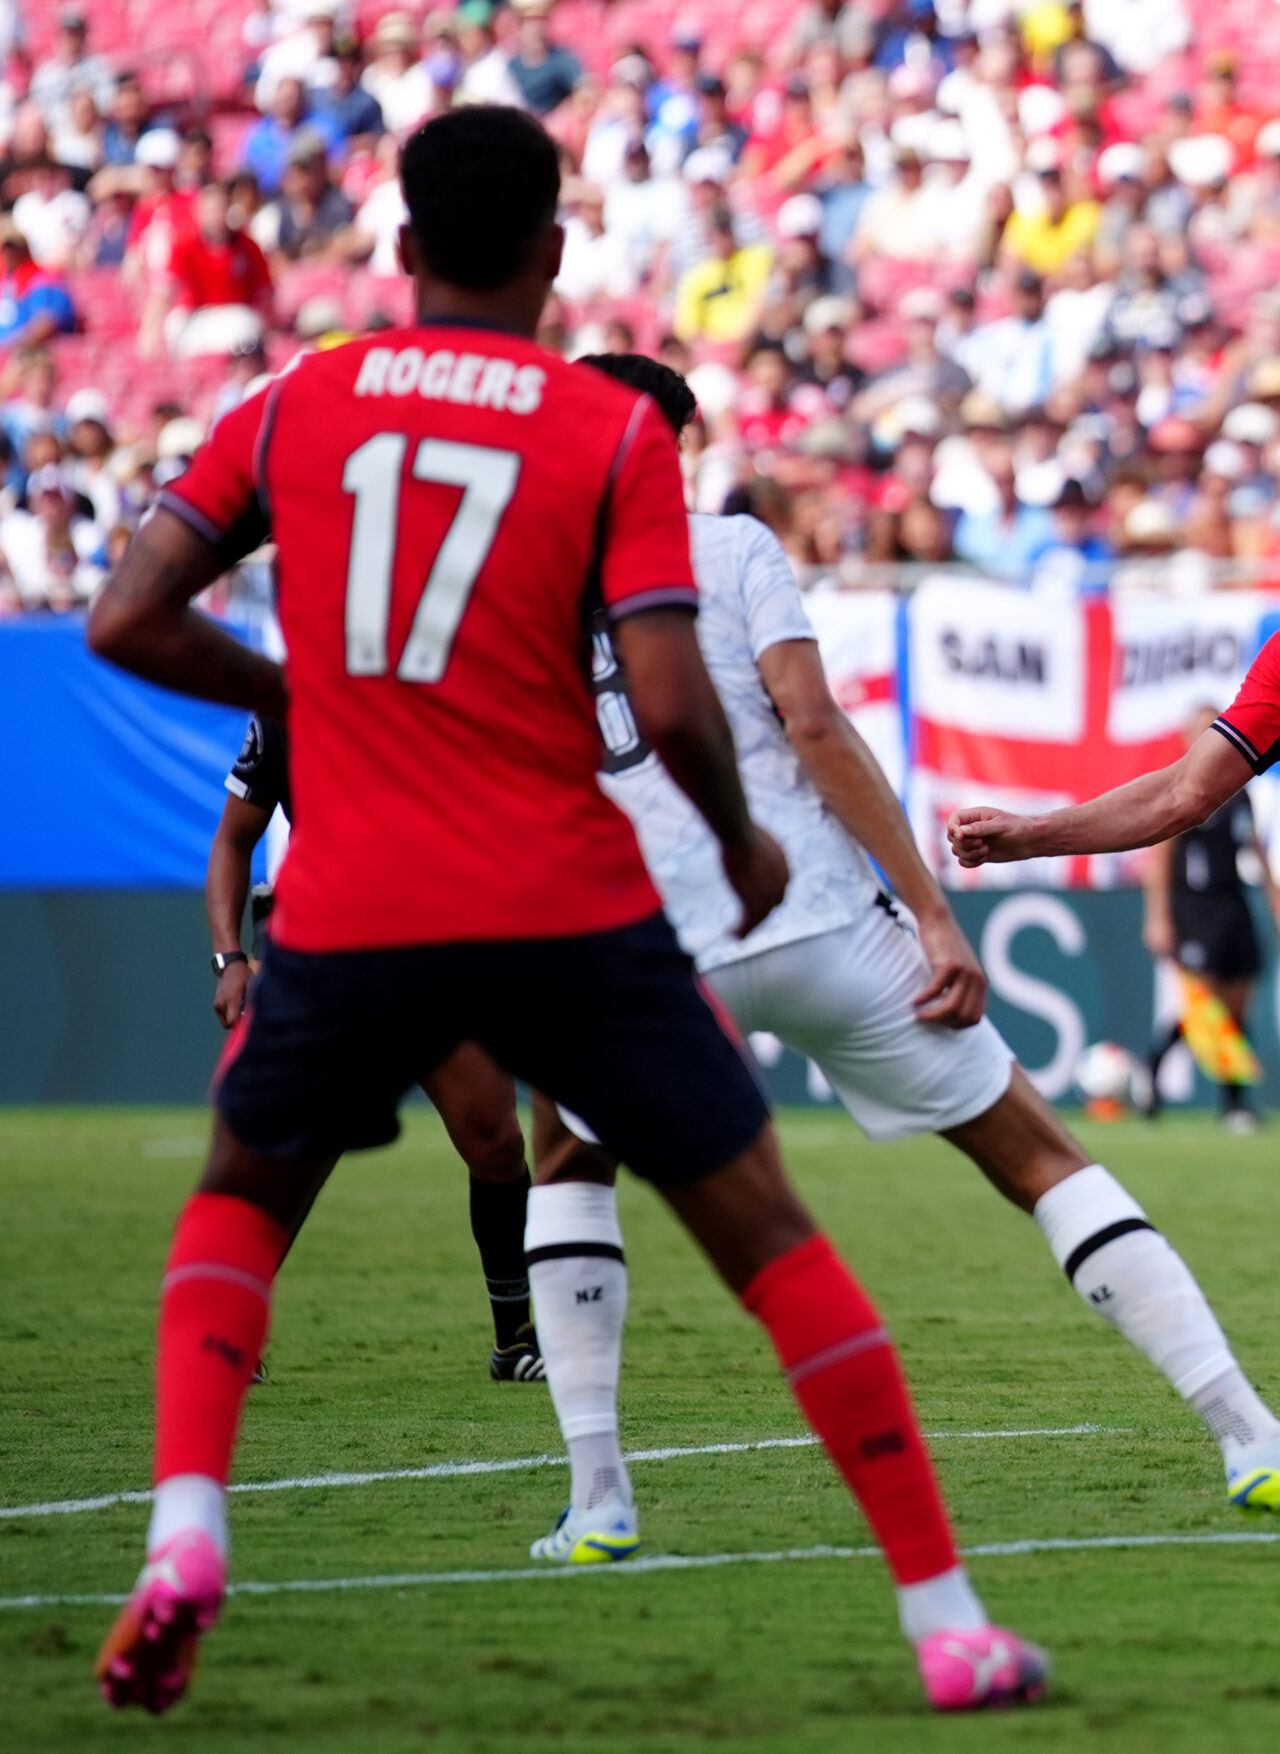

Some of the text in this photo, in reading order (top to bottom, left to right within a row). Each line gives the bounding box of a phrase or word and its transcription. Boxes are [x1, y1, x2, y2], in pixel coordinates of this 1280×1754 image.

[353, 346, 546, 416] ROGERS
[341, 430, 522, 684] 17
[938, 628, 1047, 685] SAN
